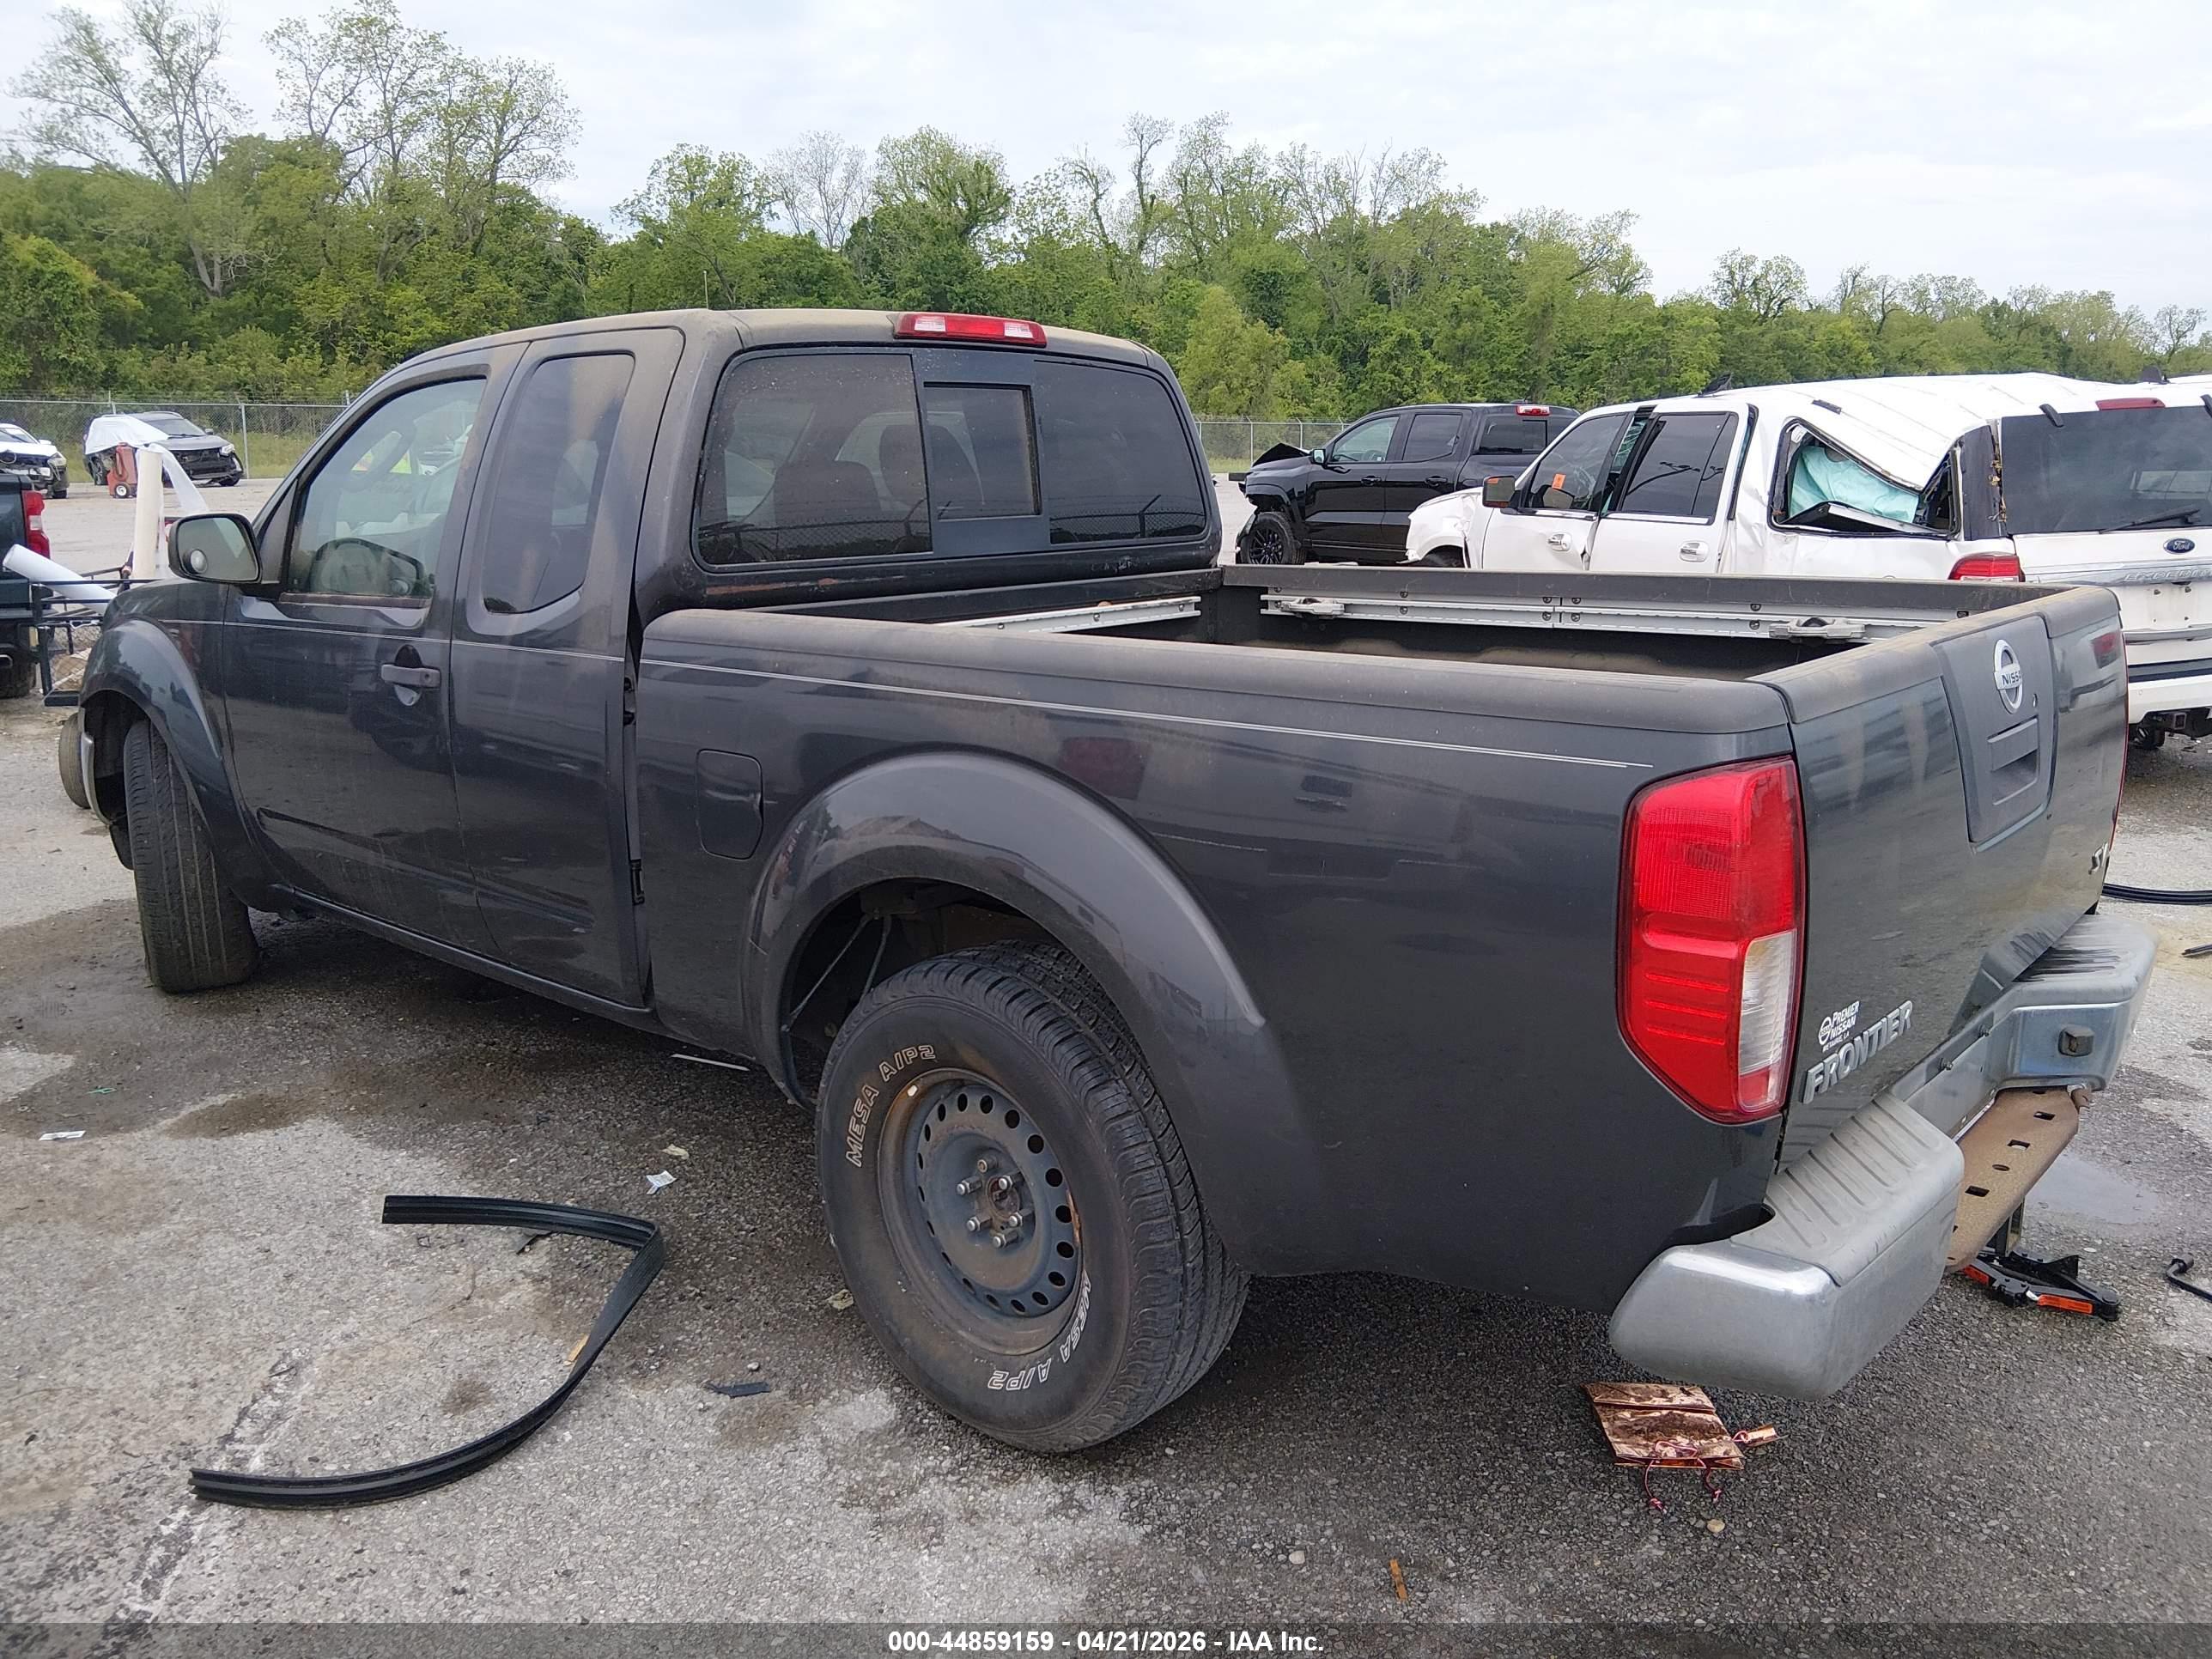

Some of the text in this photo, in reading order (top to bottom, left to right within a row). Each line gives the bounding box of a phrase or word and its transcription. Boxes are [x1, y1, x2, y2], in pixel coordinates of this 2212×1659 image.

[1802, 1000, 1912, 1104] FRONTIER
[1830, 1014, 1856, 1040] NISSAN
[1832, 1000, 1860, 1028] PREMIER
[846, 1083, 879, 1168] MESA
[1060, 1268, 1091, 1364] MESA
